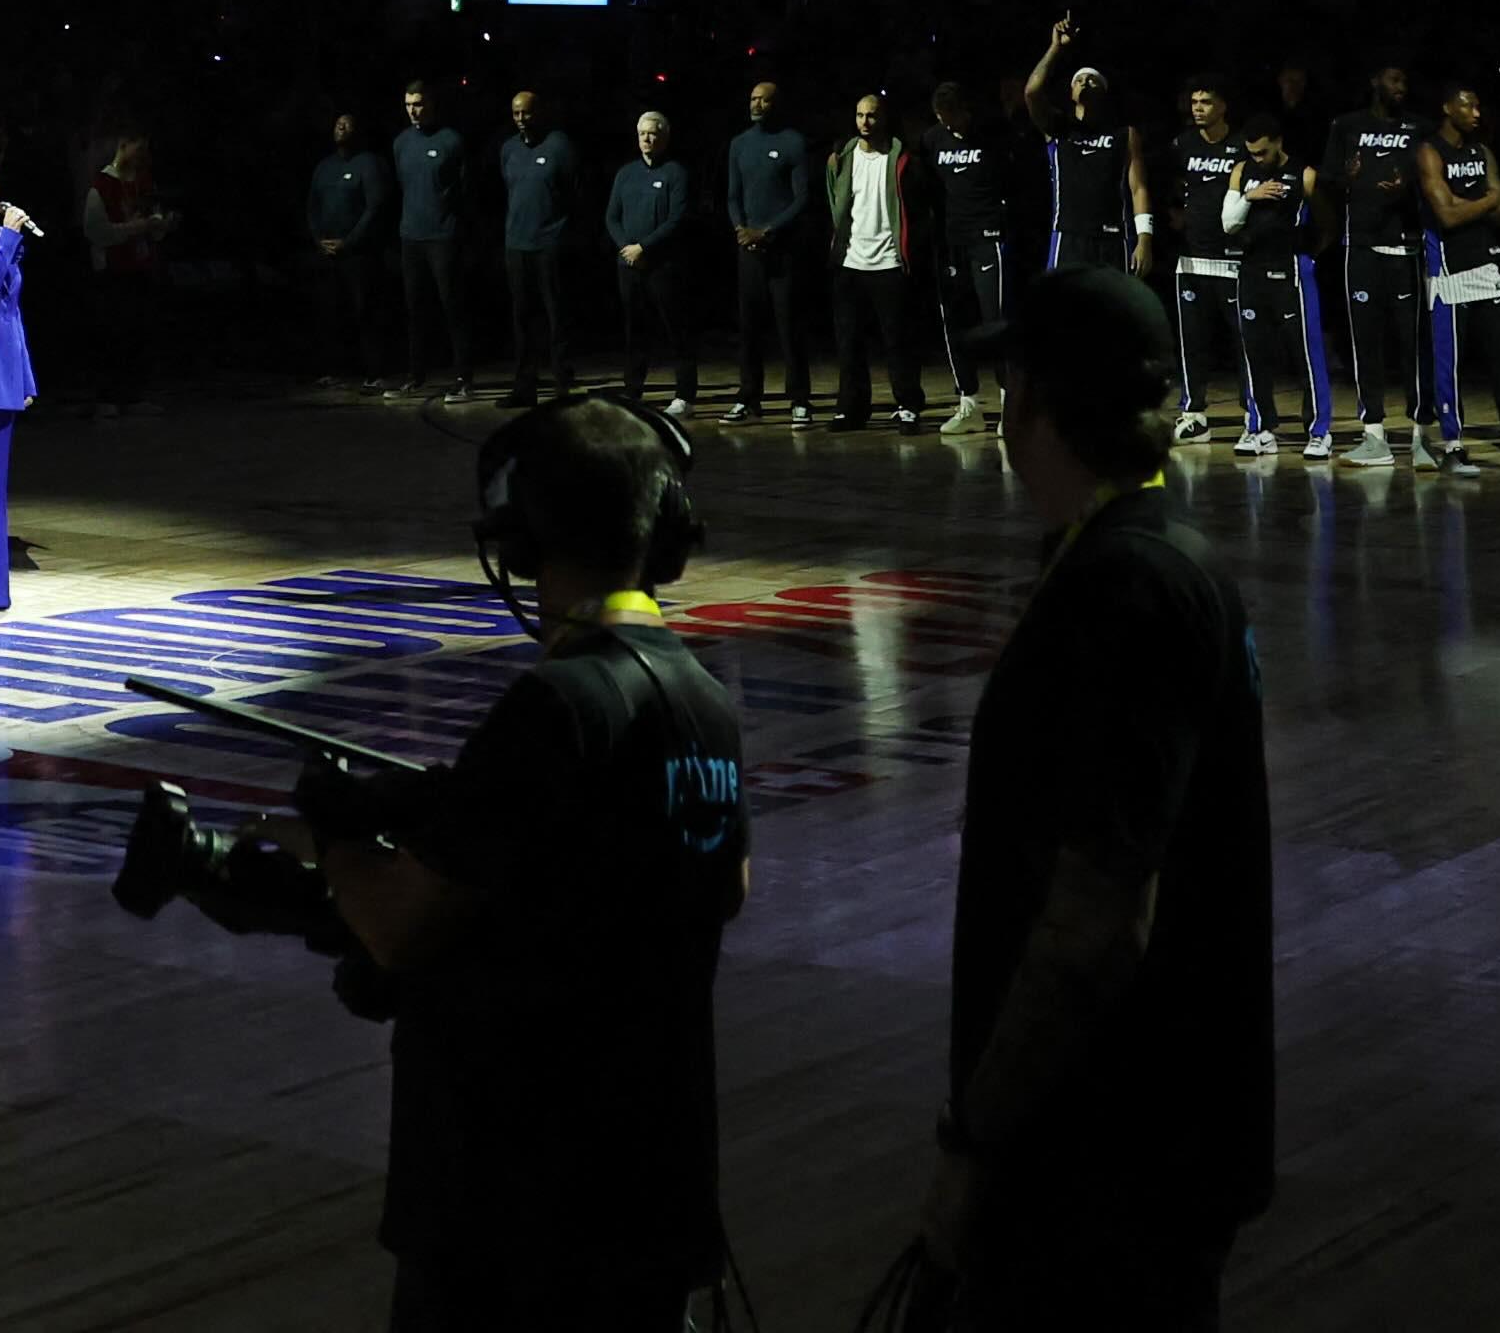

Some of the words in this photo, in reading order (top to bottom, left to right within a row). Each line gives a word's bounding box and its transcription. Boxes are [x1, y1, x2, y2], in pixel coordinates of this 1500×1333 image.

[1359, 133, 1411, 149] MAGIC
[937, 149, 983, 165] MAGIC
[1187, 157, 1235, 174] MAGIC
[1447, 161, 1486, 179] MAGIC
